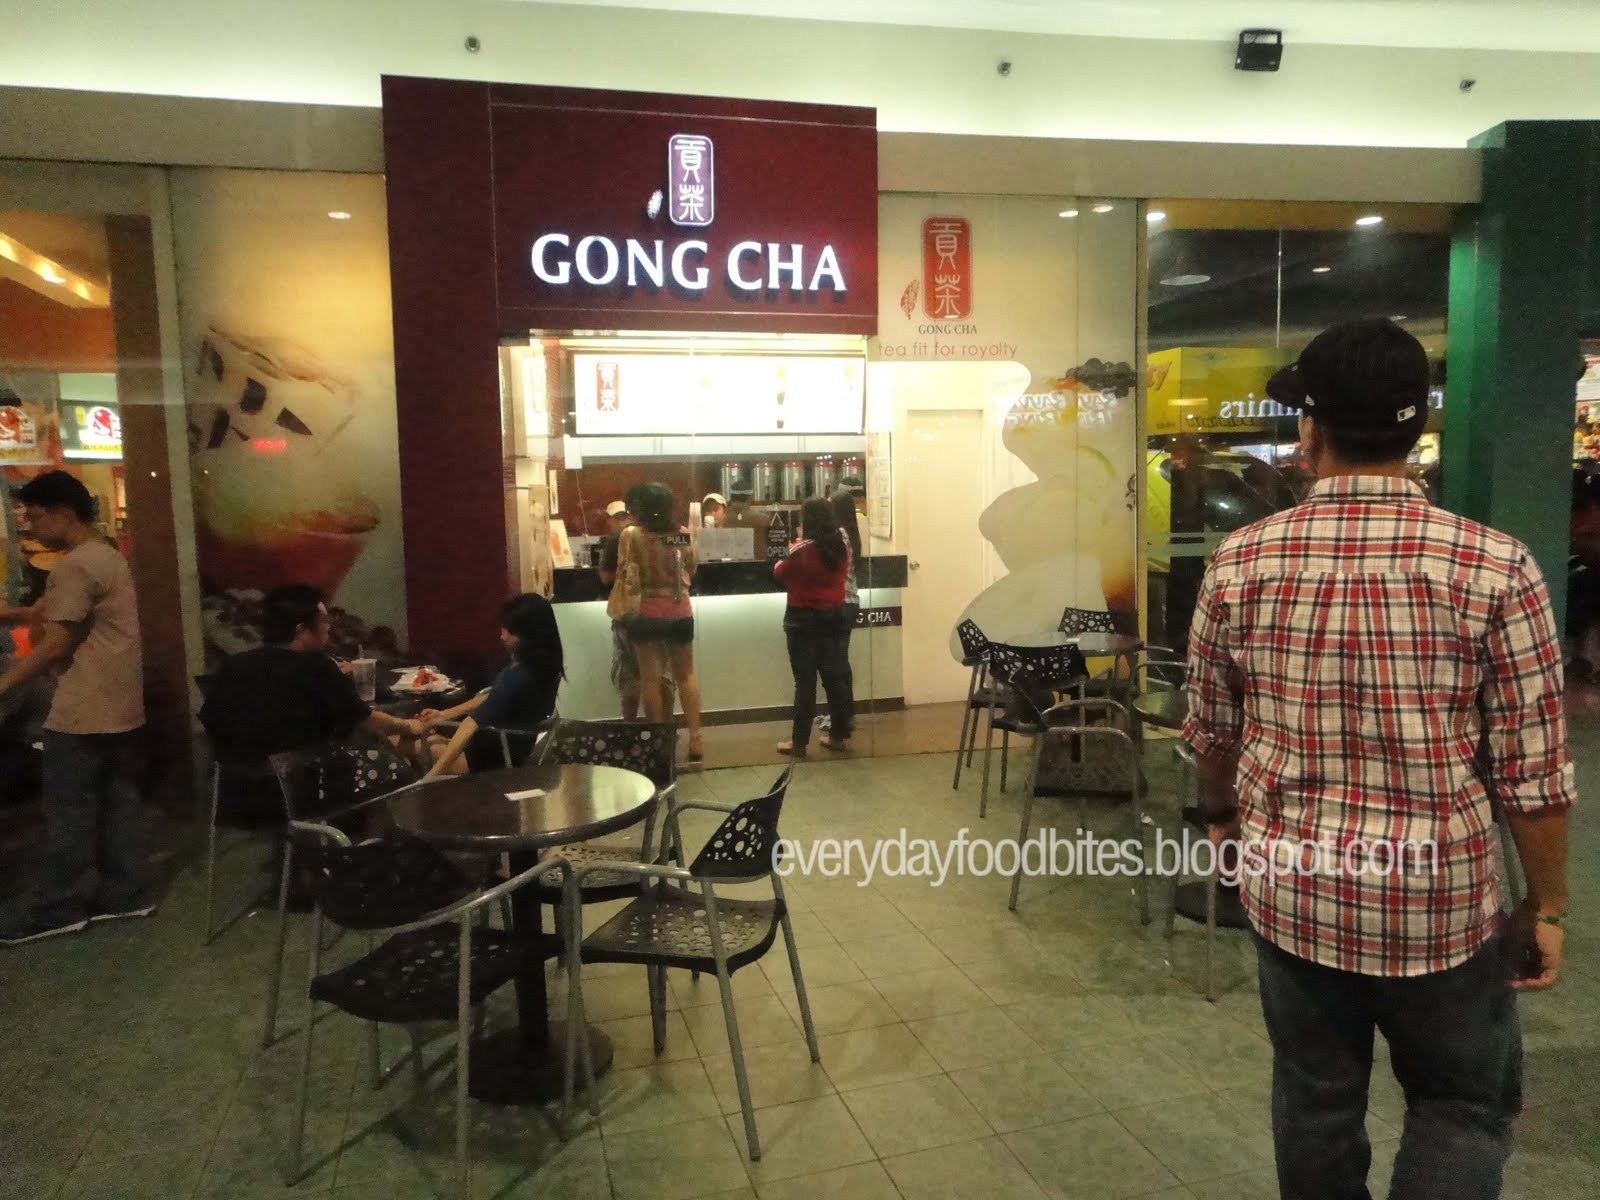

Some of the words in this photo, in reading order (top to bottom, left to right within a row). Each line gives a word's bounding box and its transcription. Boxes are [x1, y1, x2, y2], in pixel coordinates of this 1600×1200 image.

[531, 233, 709, 290] GONG
[727, 241, 848, 291] CHA
[918, 324, 951, 335] GONG
[954, 324, 978, 335] CHA
[878, 342, 906, 357] tea
[913, 341, 928, 356] fit
[934, 341, 956, 356] for
[962, 341, 1018, 359] royalty
[666, 535, 688, 545] PULL
[767, 546, 790, 557] OPEN
[867, 611, 892, 623] CHA
